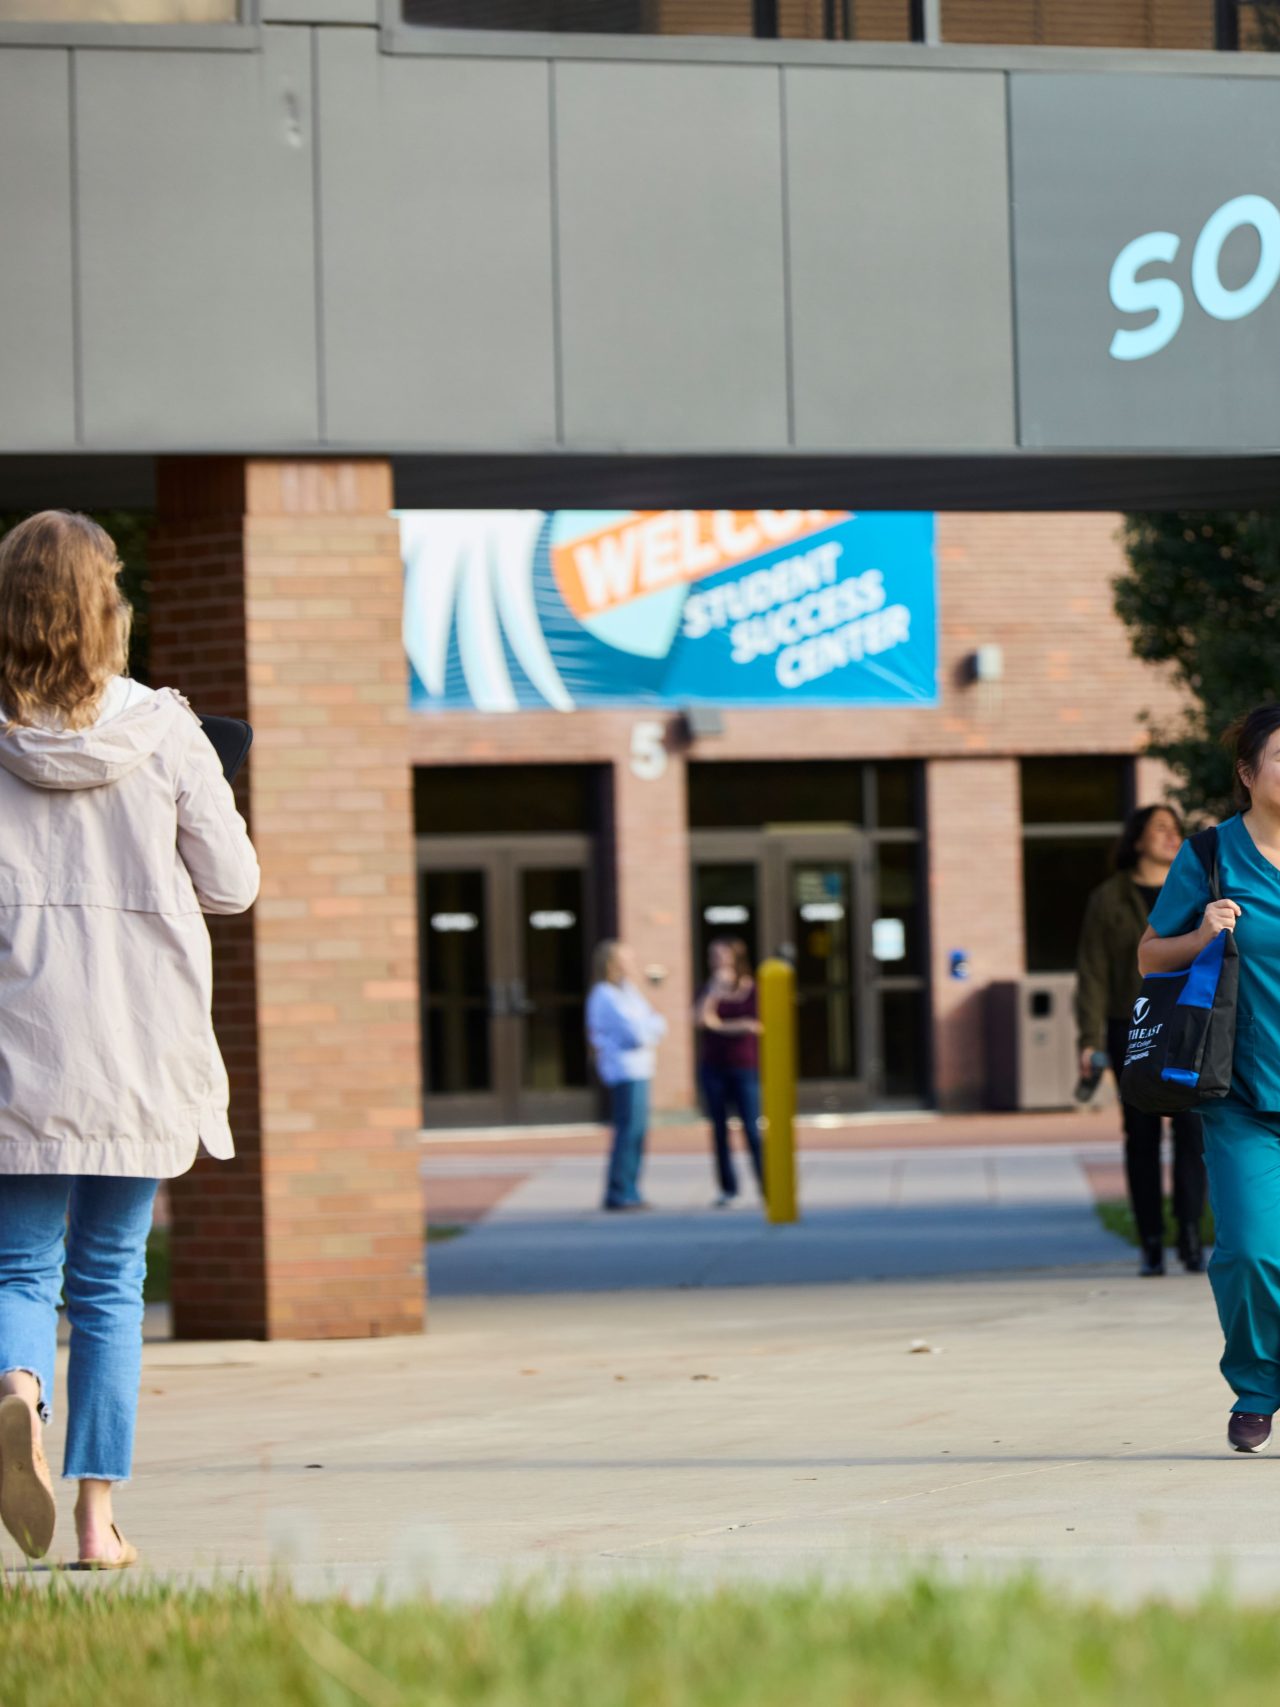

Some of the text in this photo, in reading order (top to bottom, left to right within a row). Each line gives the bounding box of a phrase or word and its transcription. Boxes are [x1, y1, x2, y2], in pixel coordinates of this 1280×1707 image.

[573, 509, 830, 609] WELC
[682, 540, 843, 638] STUDENT
[730, 568, 886, 664] SUCCESS
[775, 604, 911, 688] CENTER
[630, 721, 667, 779] 5
